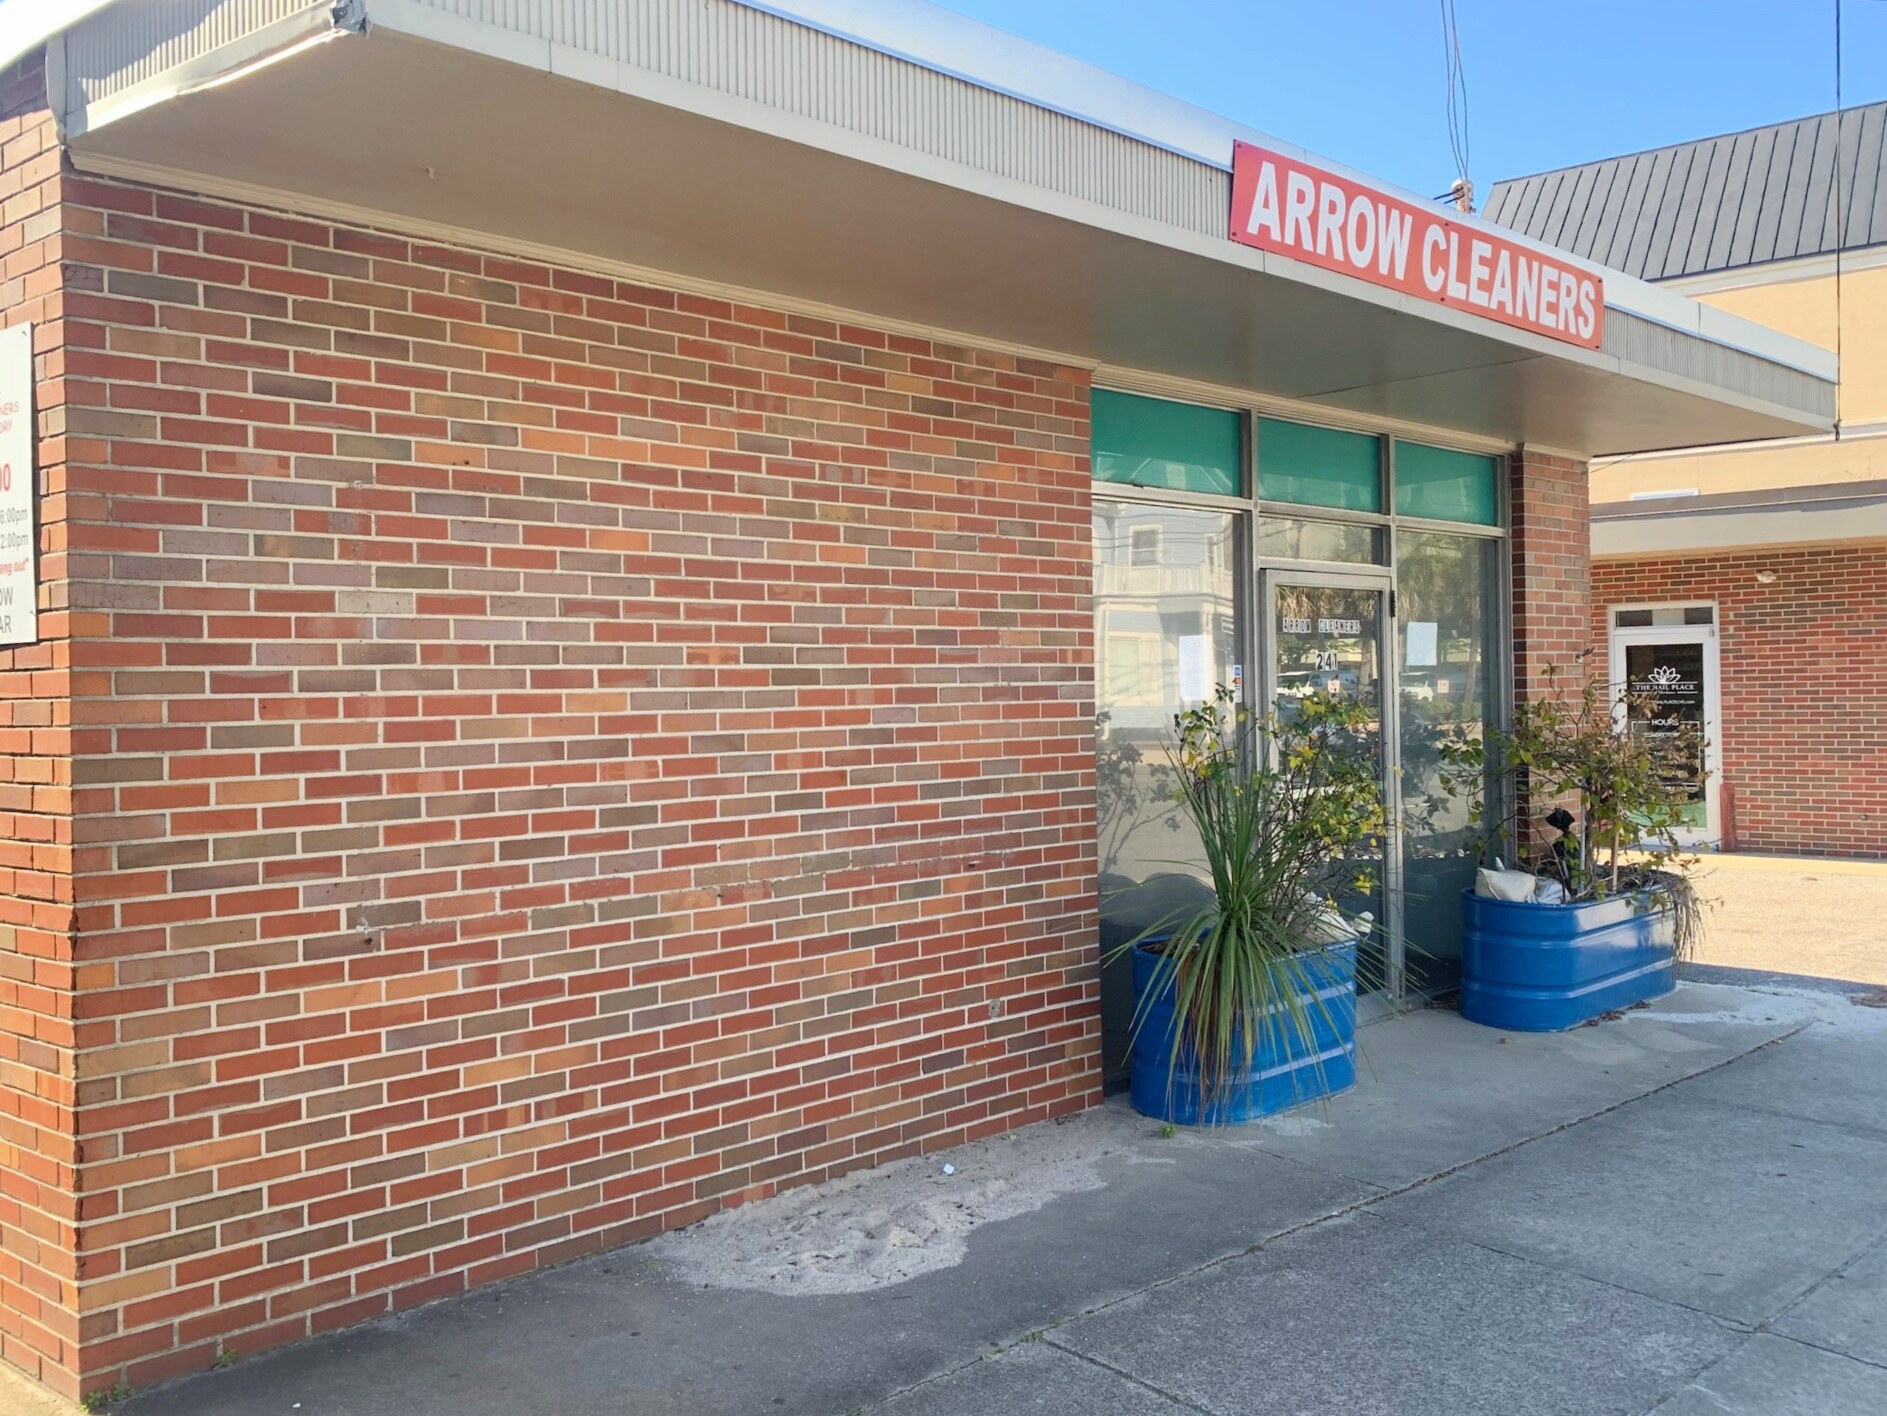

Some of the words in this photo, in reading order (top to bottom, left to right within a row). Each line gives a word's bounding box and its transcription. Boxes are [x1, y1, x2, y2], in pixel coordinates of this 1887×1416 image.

[1247, 160, 1413, 281] ARROW
[1422, 223, 1595, 340] CLEANERS
[1317, 653, 1337, 671] 241
